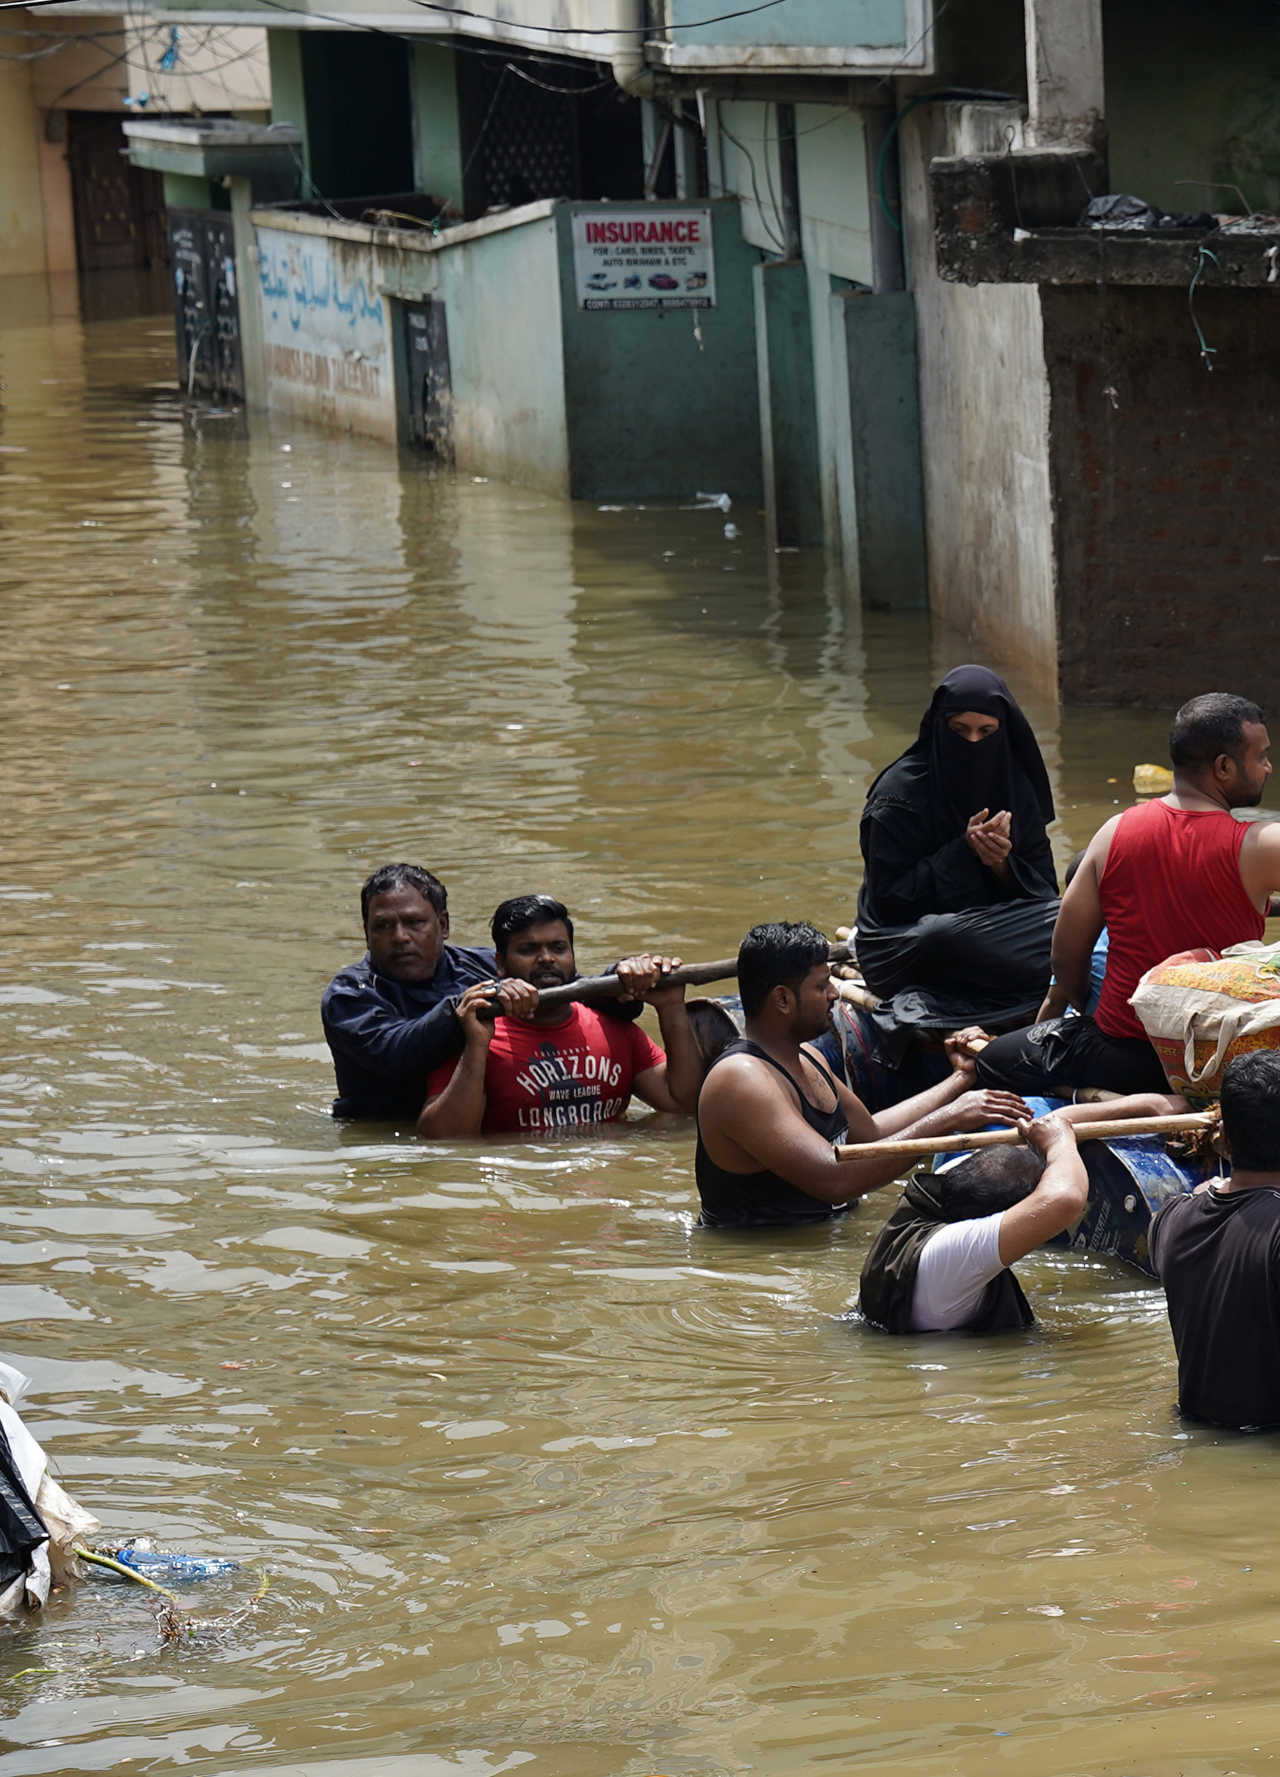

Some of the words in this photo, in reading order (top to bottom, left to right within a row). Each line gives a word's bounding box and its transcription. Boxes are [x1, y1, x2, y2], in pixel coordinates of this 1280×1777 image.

[585, 220, 700, 244] INSURANCE
[516, 1055, 622, 1096] HORIZONS
[549, 1089, 570, 1101] WAVE
[573, 1084, 601, 1099] LEAGUE
[518, 1097, 622, 1128] LONGBOARD
